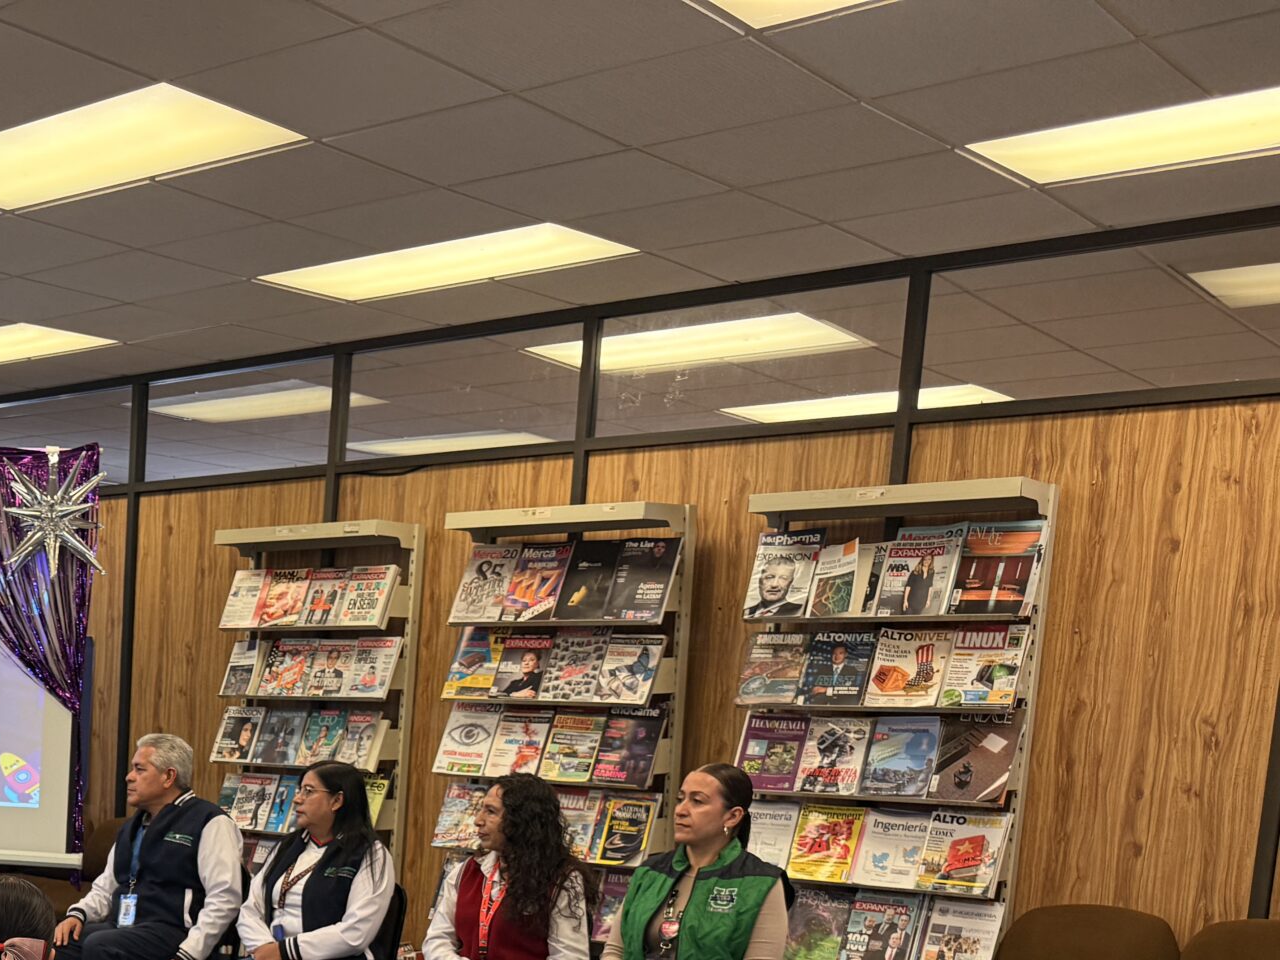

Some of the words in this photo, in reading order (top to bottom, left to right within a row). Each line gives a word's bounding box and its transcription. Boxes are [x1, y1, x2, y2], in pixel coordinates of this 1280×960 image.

[956, 631, 1006, 648] LINUX
[750, 811, 792, 821] ngeniería
[873, 818, 928, 833] Ingeniería
